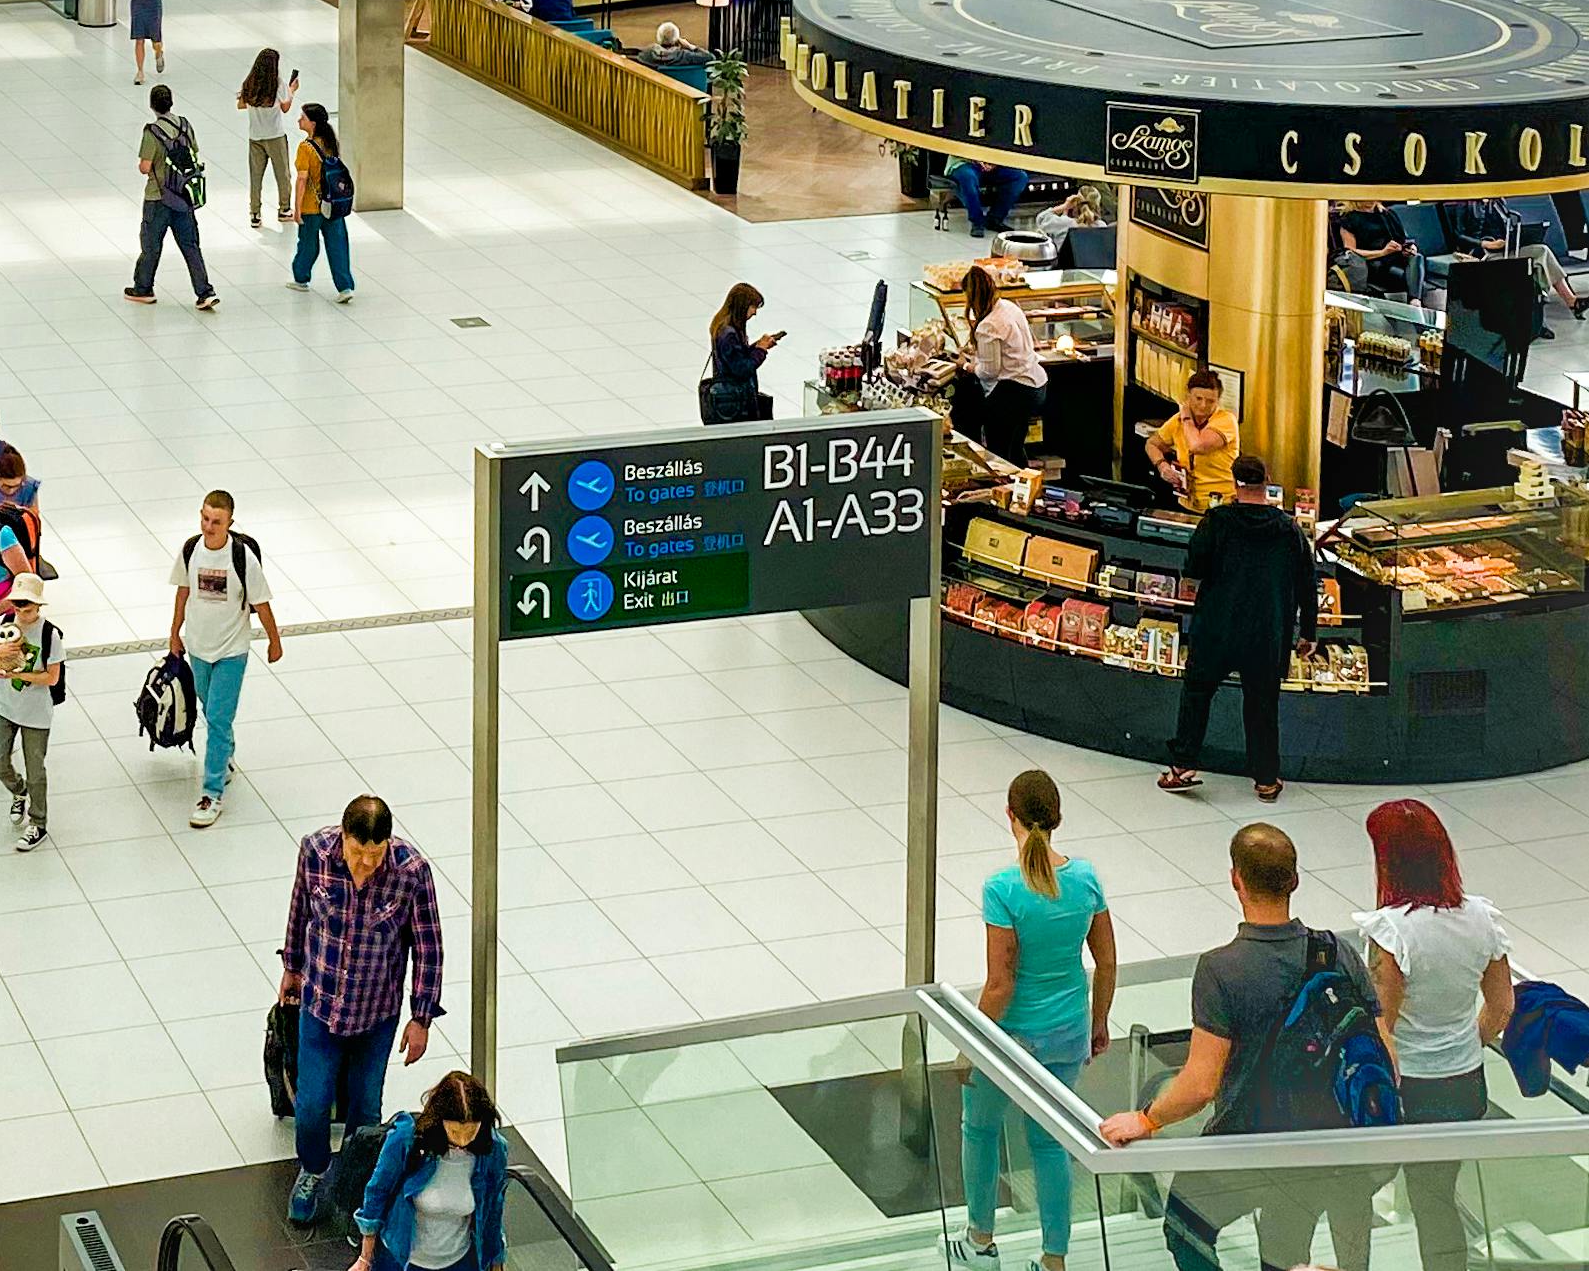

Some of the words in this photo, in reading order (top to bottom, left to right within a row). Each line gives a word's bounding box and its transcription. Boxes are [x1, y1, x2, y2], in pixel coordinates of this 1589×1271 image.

[1171, 72, 1482, 96] CHOCOLATIER
[1111, 124, 1193, 170] Szamos
[624, 459, 704, 481] Beszállás
[763, 433, 915, 491] B1-B44
[625, 486, 645, 503] To
[649, 485, 695, 504] gates
[624, 513, 703, 536] Beszállás
[763, 489, 924, 546] A1-A33
[625, 541, 645, 558] To
[649, 539, 695, 558] gates
[623, 568, 678, 590] Kijárat
[623, 591, 654, 610] Exit
